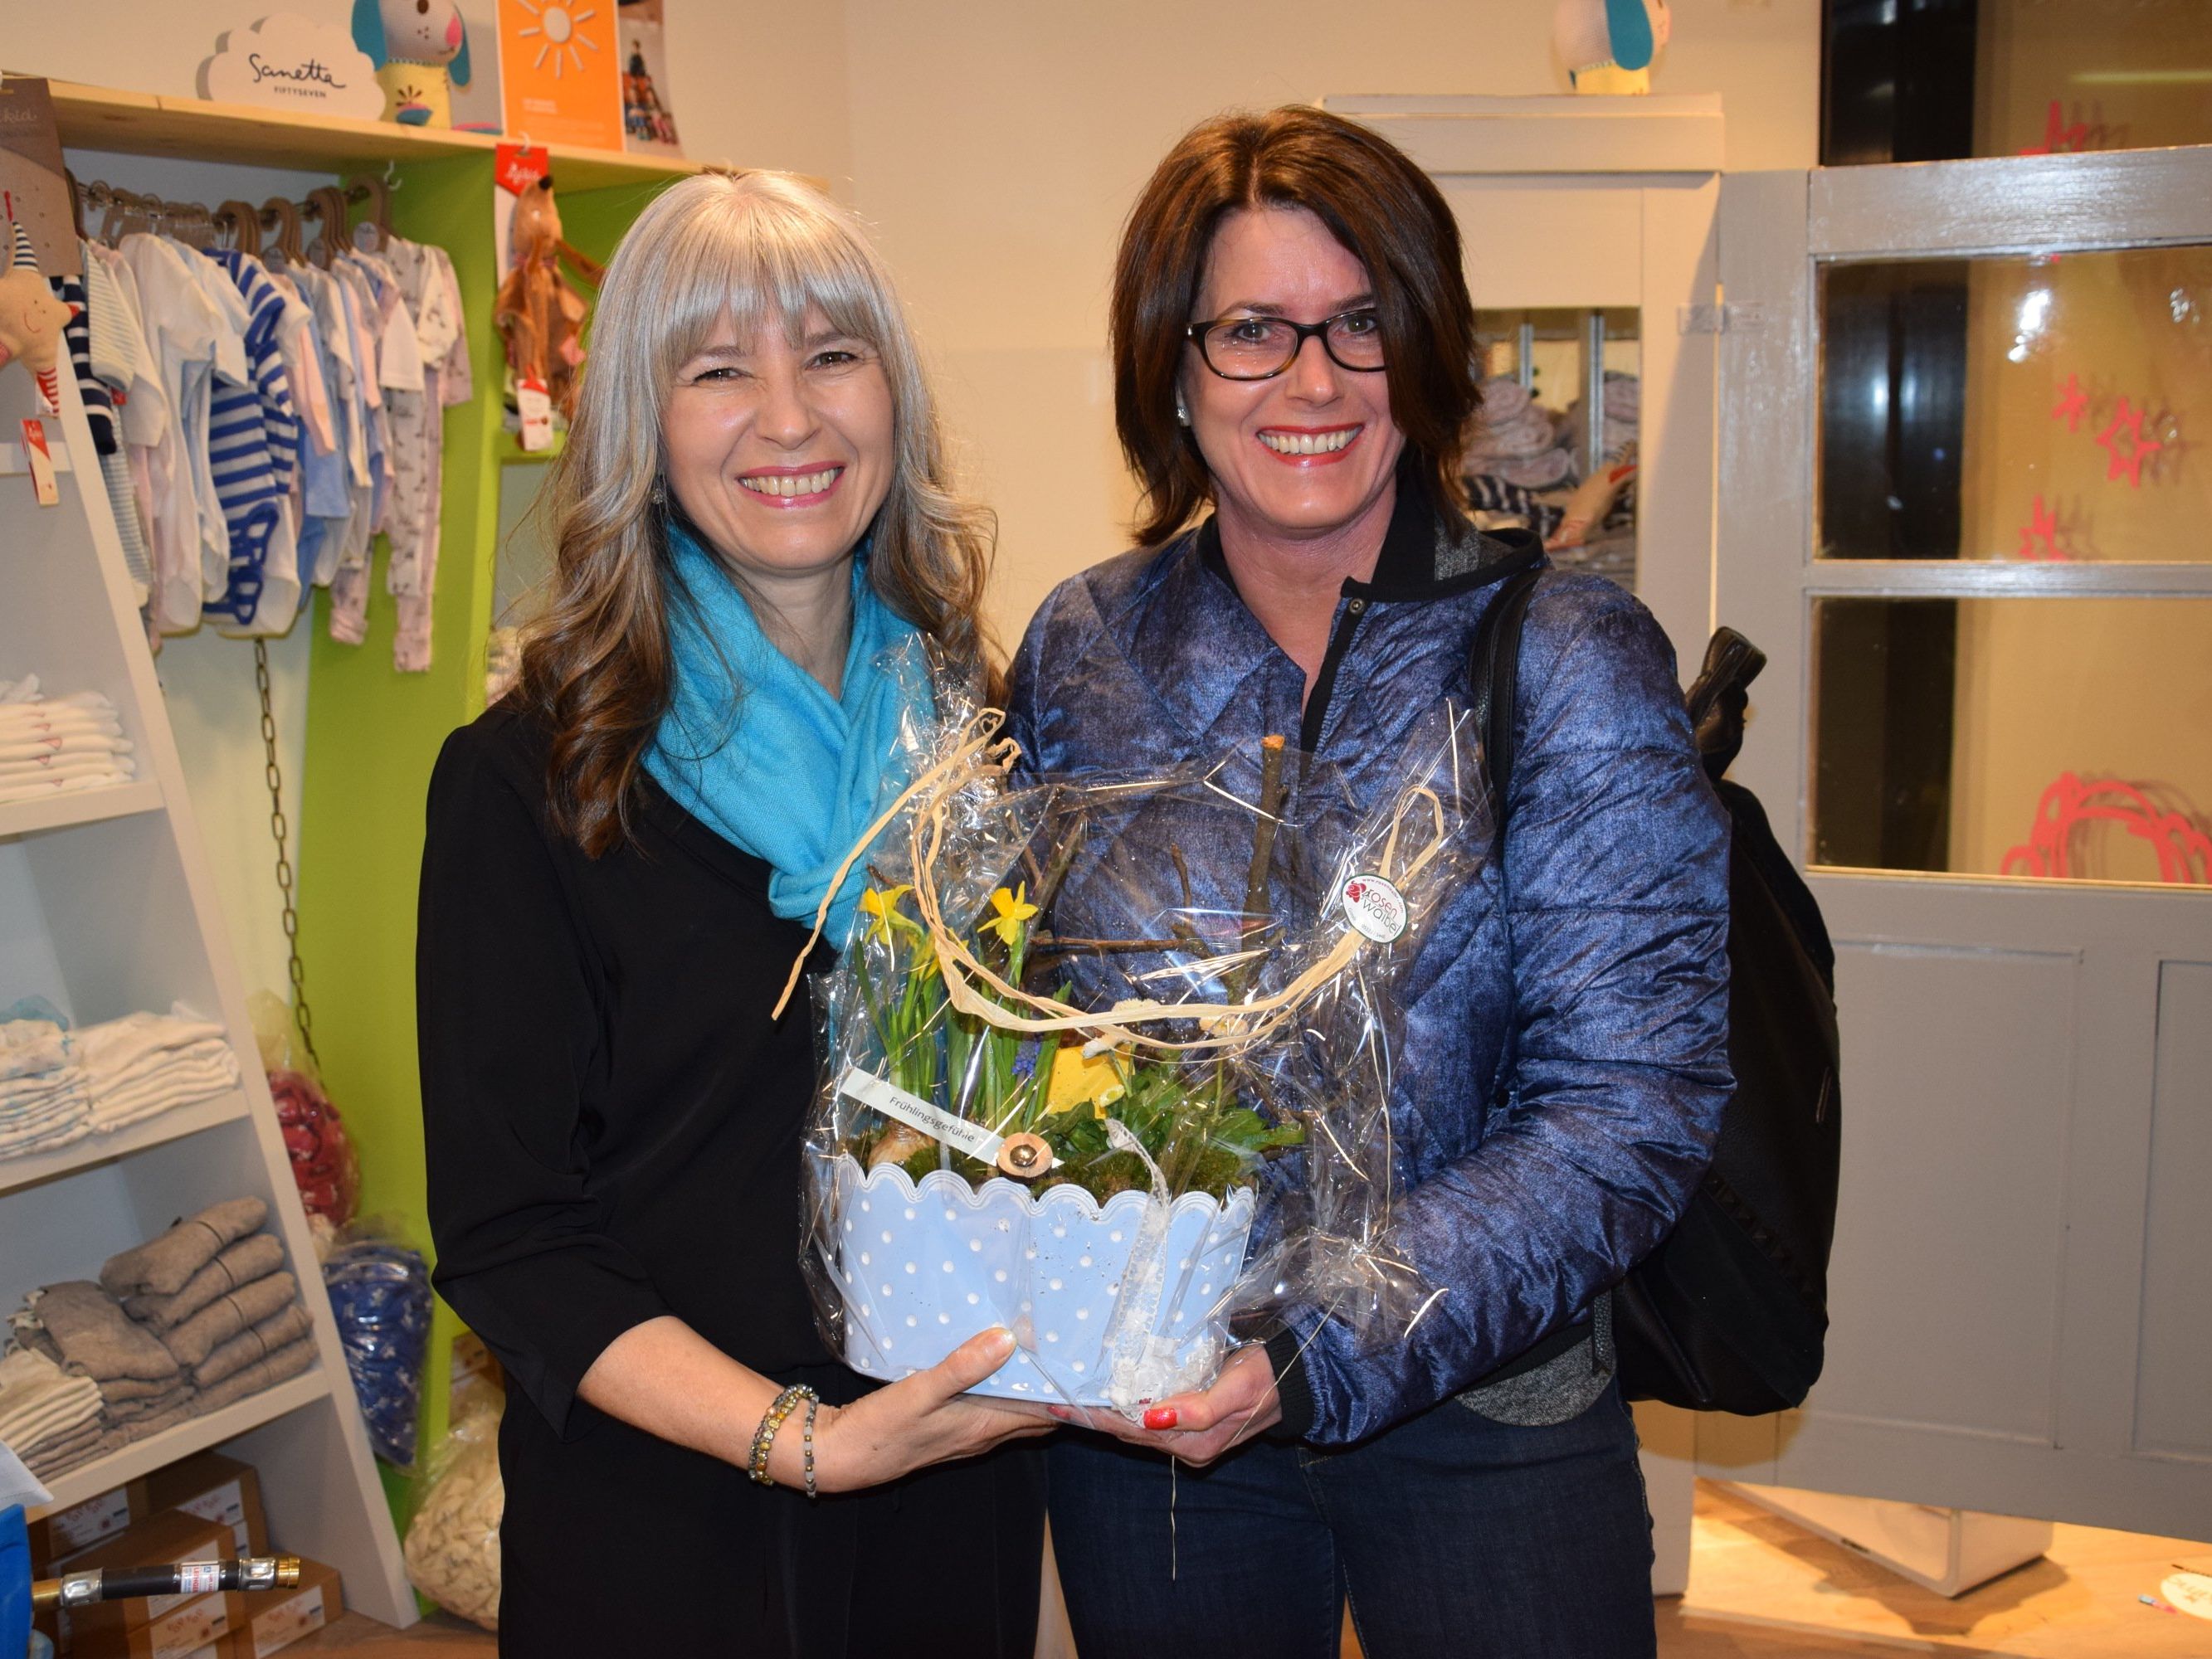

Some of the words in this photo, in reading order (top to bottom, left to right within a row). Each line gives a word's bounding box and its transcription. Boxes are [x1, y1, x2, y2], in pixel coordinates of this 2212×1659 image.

[248, 53, 347, 89] Sanetta
[274, 85, 327, 98] FIFTYSEVEN
[1362, 898, 1402, 937] waibel
